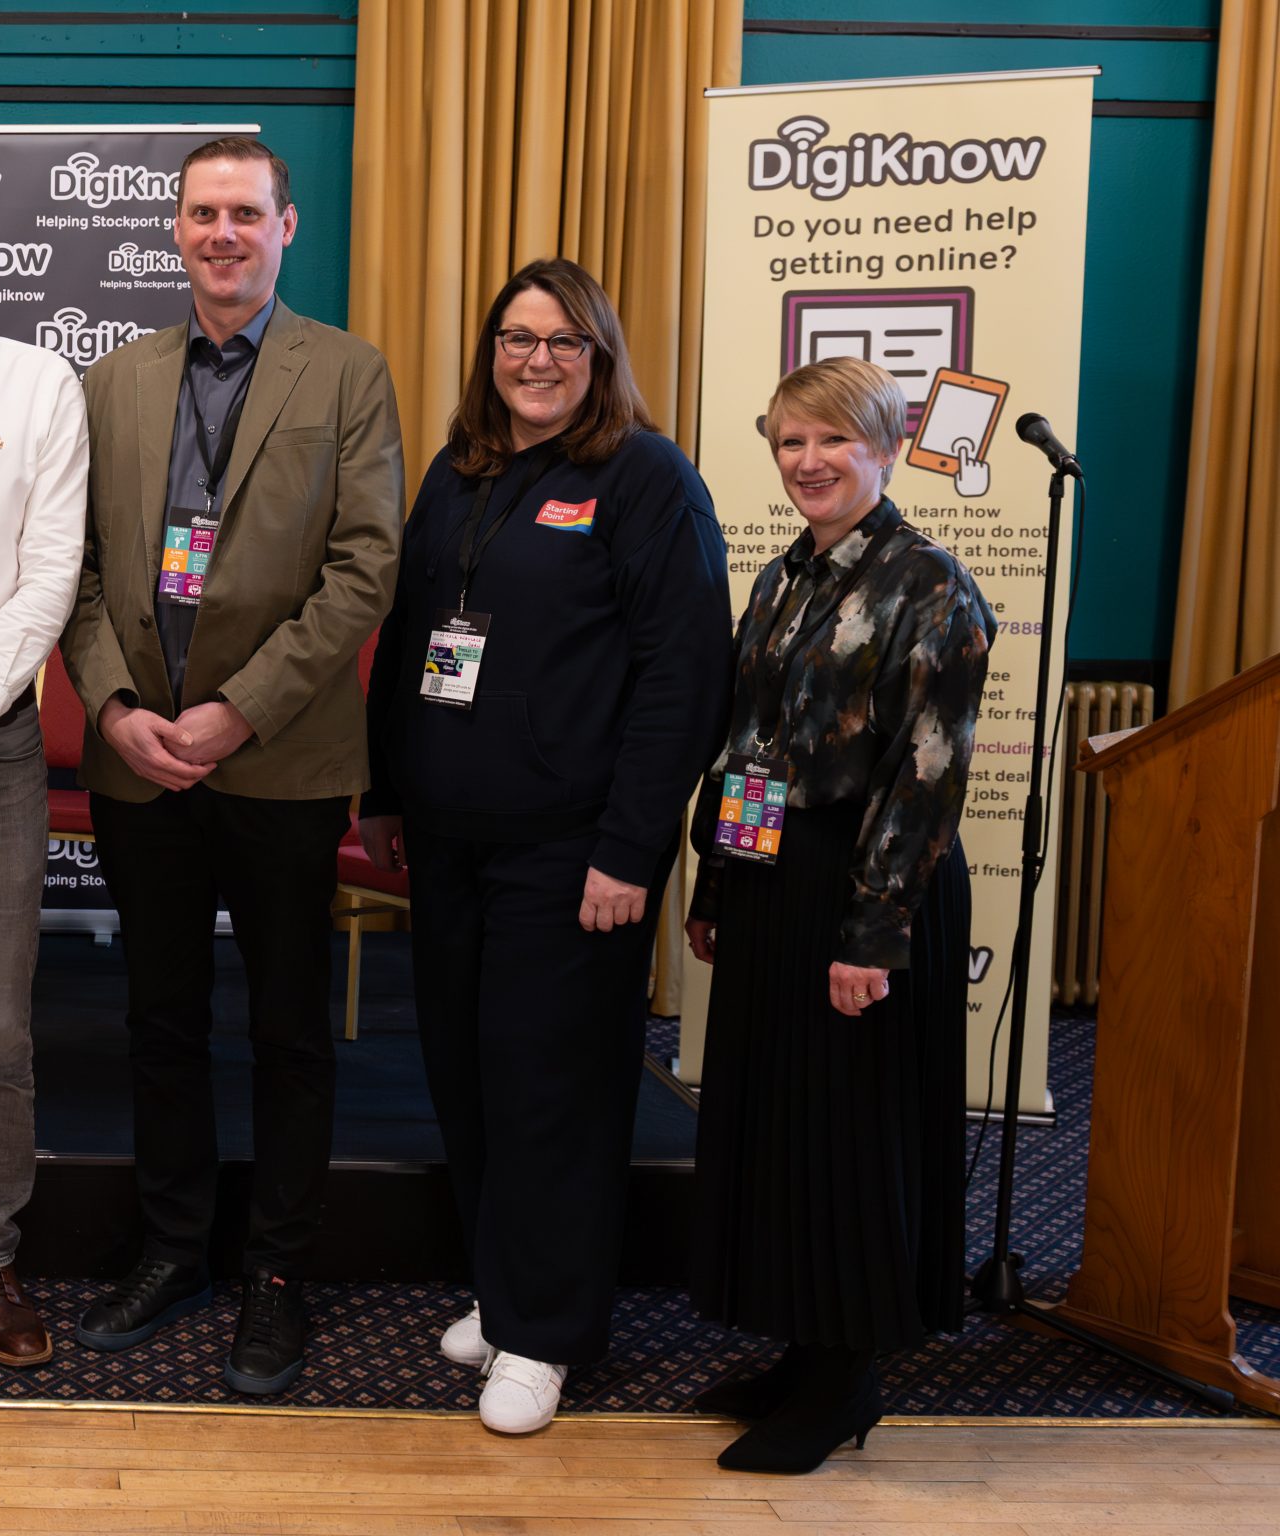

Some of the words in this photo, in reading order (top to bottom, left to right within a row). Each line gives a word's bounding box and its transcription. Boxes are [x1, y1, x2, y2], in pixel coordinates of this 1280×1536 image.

[748, 132, 1046, 201] DigiKnow
[36, 215, 89, 230] Helping
[92, 215, 160, 230] Stockport
[754, 215, 795, 238] Do
[804, 217, 862, 243] you
[873, 208, 953, 235] need
[965, 205, 1037, 236] help
[769, 249, 884, 282] getting
[895, 244, 1017, 273] online?
[100, 280, 132, 290] Helping
[133, 280, 175, 290] Stockport
[177, 281, 191, 290] get
[542, 511, 564, 520] Point
[545, 504, 578, 515] Starting
[768, 504, 795, 517] We
[913, 505, 958, 518] learn
[963, 505, 1001, 519] how
[743, 522, 765, 536] do
[938, 523, 951, 537] if
[953, 527, 986, 541] you
[990, 524, 1014, 538] do
[1018, 525, 1050, 539] not
[725, 540, 767, 555] have
[964, 544, 982, 557] at
[987, 543, 1043, 558] home.
[1000, 563, 1047, 578] think
[987, 706, 1012, 720] for
[971, 787, 1010, 803] jobs
